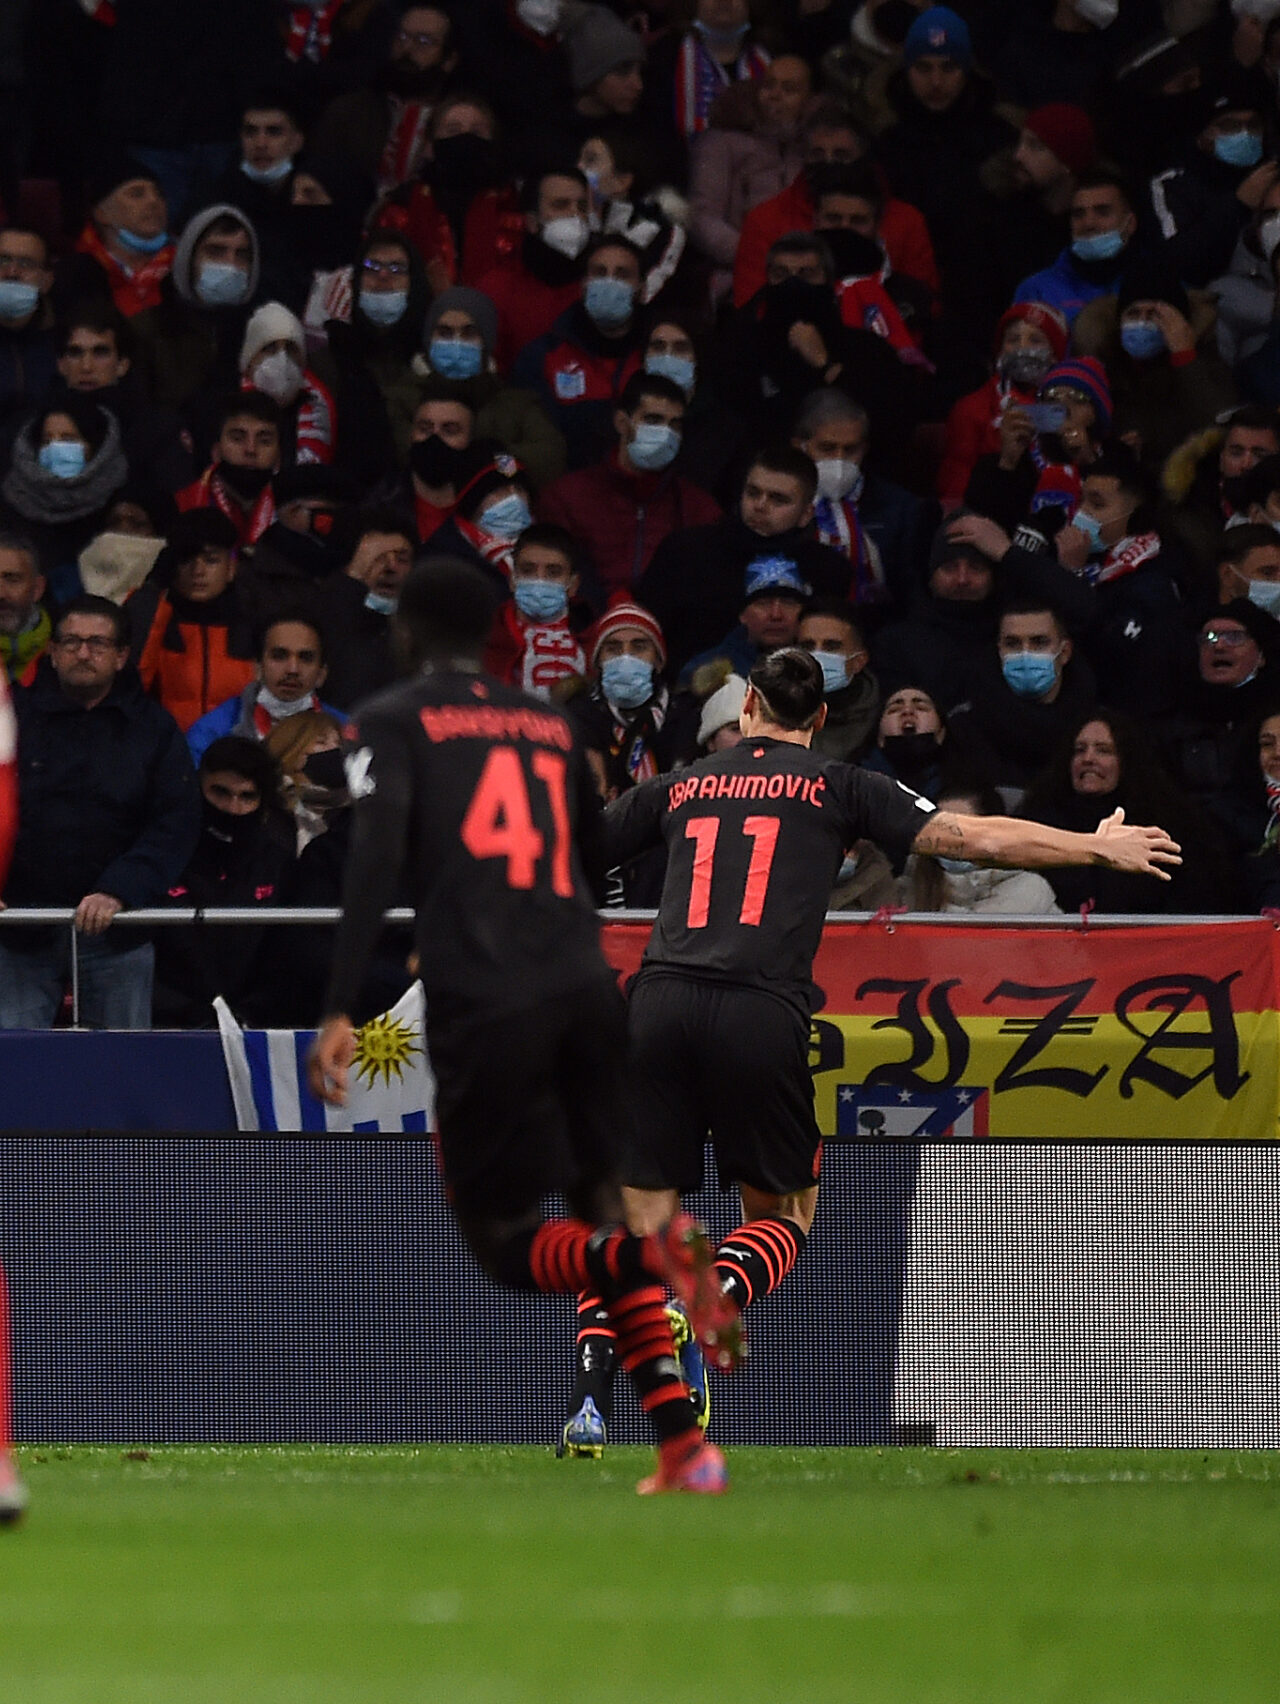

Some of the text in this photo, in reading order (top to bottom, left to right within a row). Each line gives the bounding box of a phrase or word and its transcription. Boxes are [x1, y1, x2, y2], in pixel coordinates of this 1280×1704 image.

[461, 745, 575, 899] 41
[668, 774, 826, 813] IBRAHIMOVIĆ
[685, 815, 781, 929] 11
